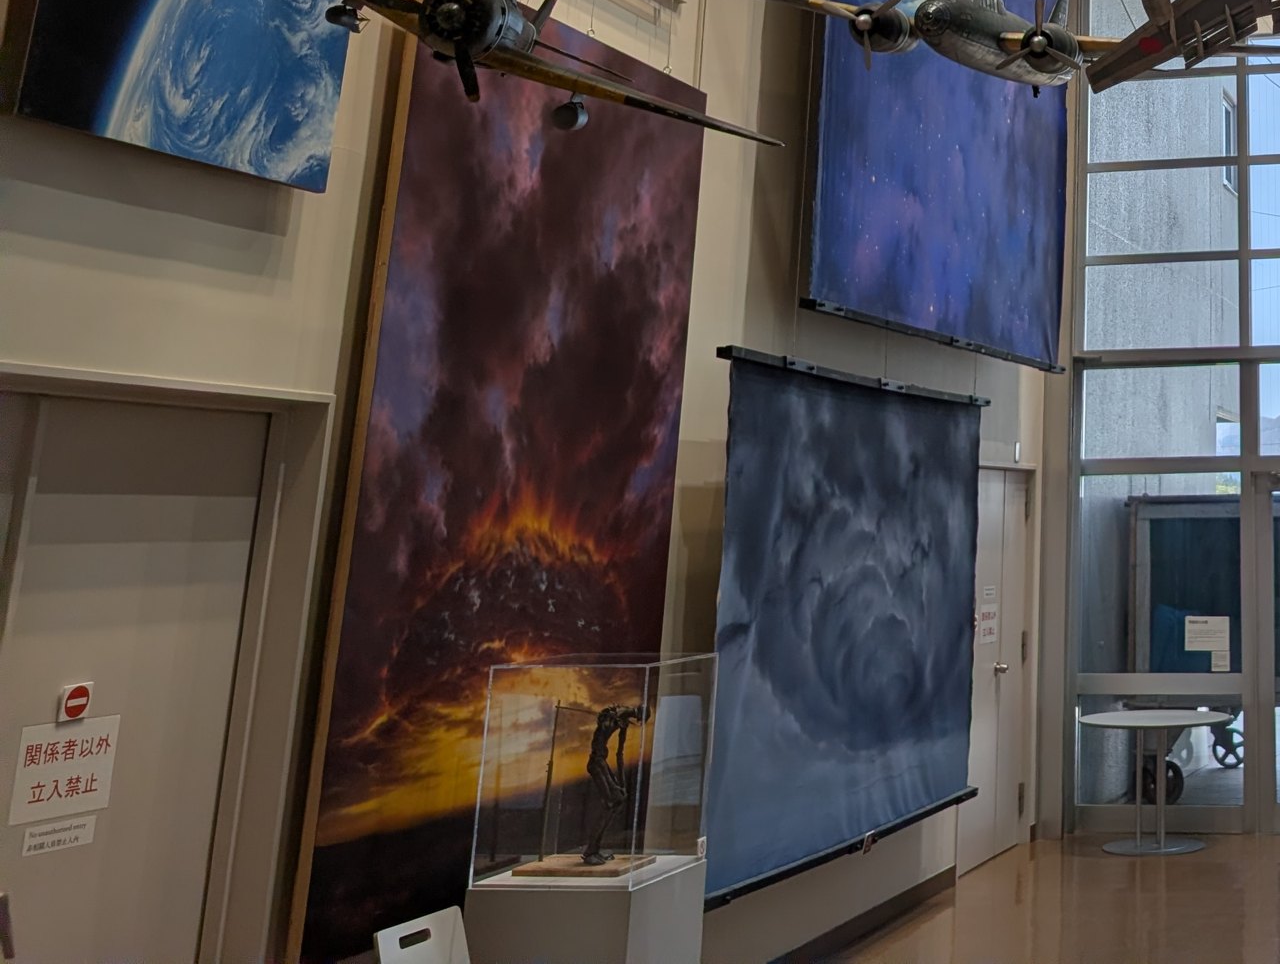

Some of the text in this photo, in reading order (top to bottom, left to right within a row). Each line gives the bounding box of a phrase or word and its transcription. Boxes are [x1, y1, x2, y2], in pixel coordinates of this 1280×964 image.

[24, 734, 111, 768] 関係者以外
[27, 772, 98, 804] 立入禁止
